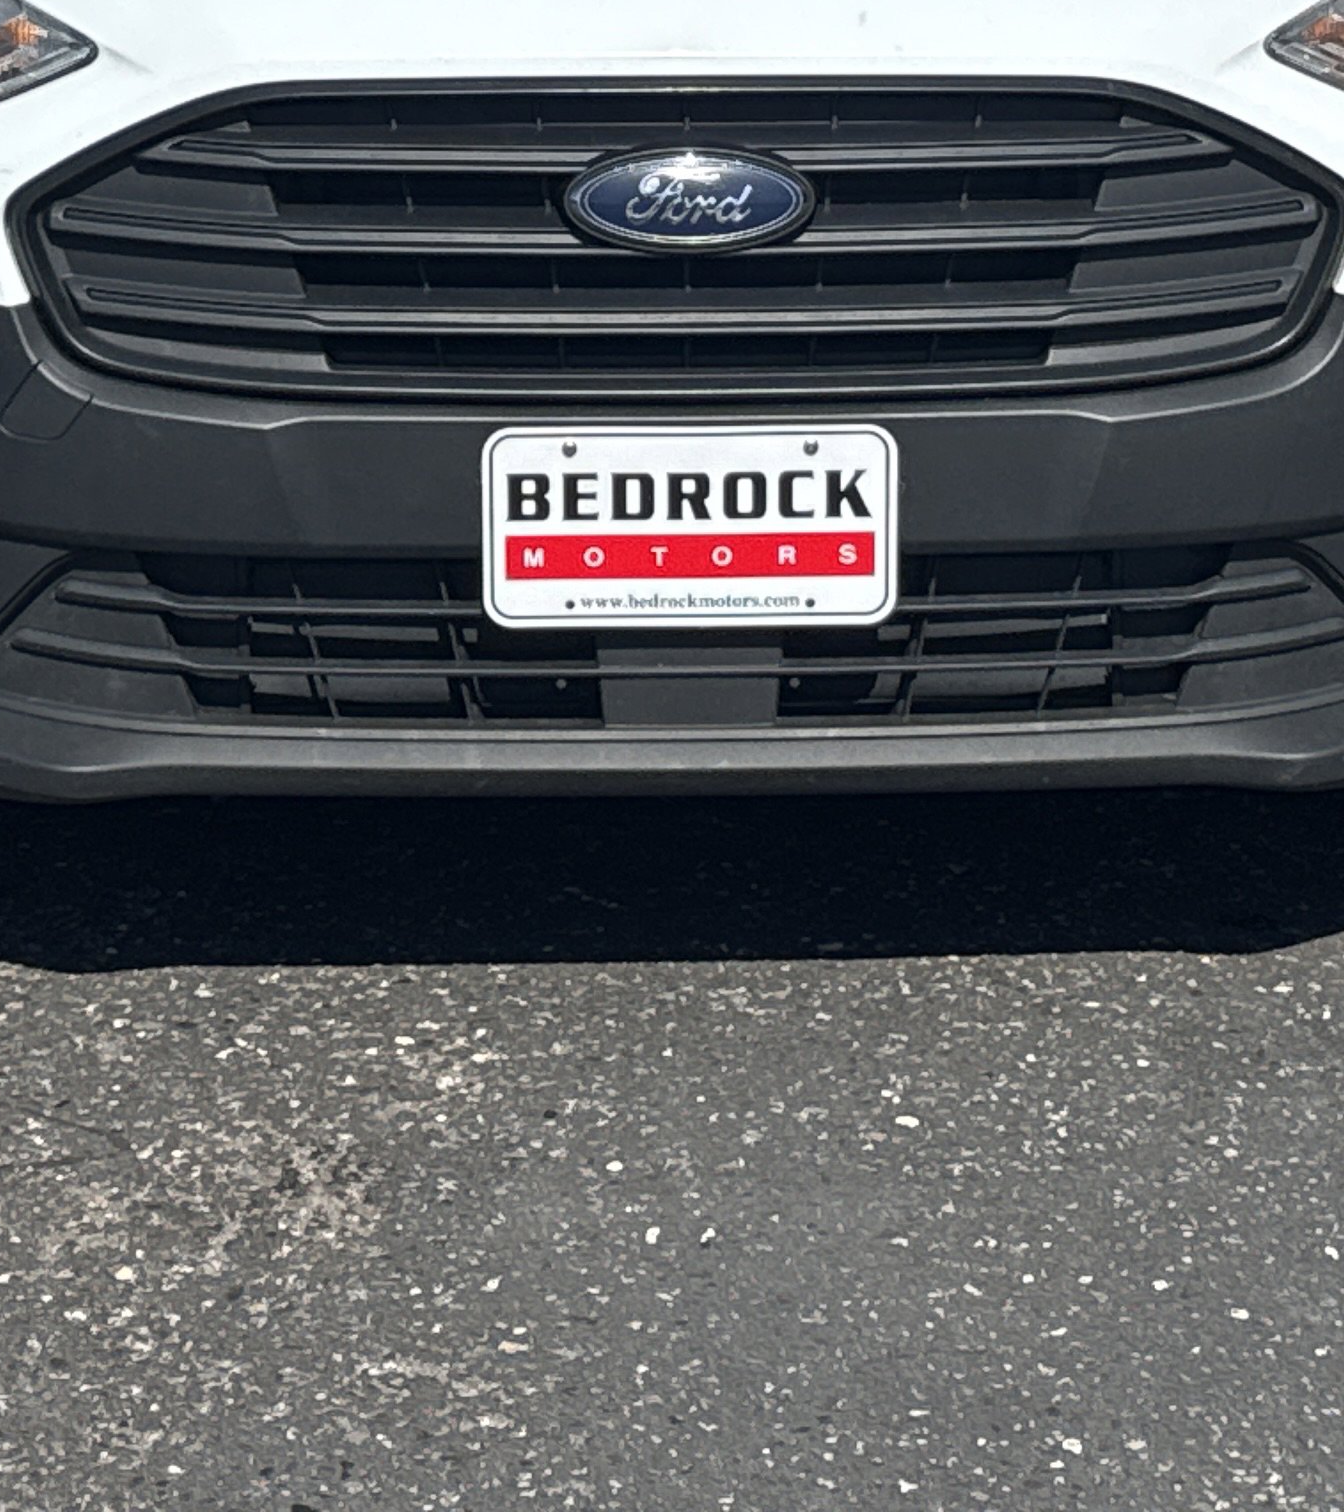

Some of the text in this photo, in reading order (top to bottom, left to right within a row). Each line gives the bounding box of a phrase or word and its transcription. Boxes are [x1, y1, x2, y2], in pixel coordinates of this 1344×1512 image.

[625, 171, 754, 226] Ford
[505, 469, 873, 522] BEDROCK
[522, 543, 859, 569] MOTORS
[579, 592, 801, 610] www.bedrockmotors.com
